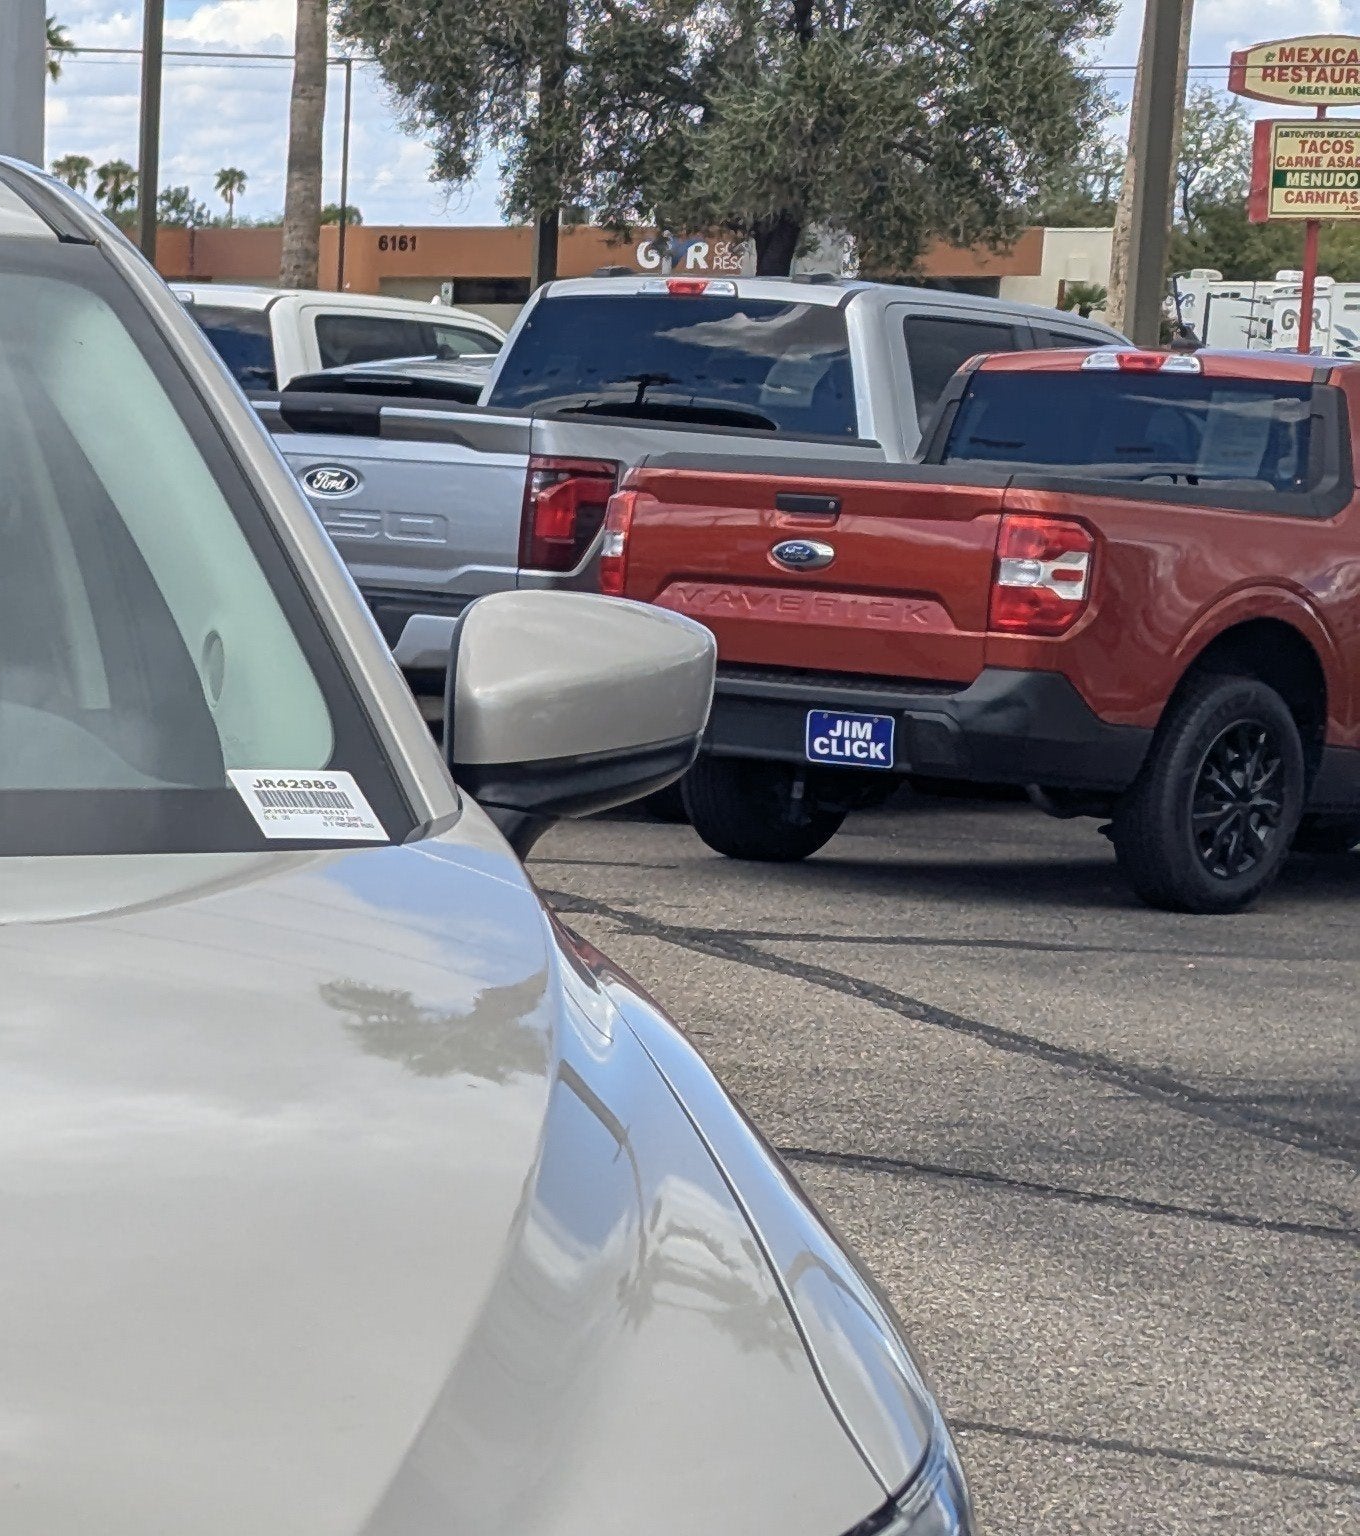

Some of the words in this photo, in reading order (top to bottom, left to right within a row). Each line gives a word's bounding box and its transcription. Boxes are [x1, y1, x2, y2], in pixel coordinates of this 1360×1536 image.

[1278, 46, 1360, 64] MEXICA
[1297, 86, 1326, 95] MEAT
[1298, 139, 1355, 154] TACOS
[1276, 155, 1323, 168] CARNE
[1285, 171, 1359, 187] MENUDO
[1284, 190, 1359, 204] CARNITAS
[378, 234, 417, 251] 6161
[312, 470, 349, 490] Ford
[676, 587, 928, 624] MAVERICK
[828, 719, 873, 740] JIM
[813, 736, 886, 760] CLICK
